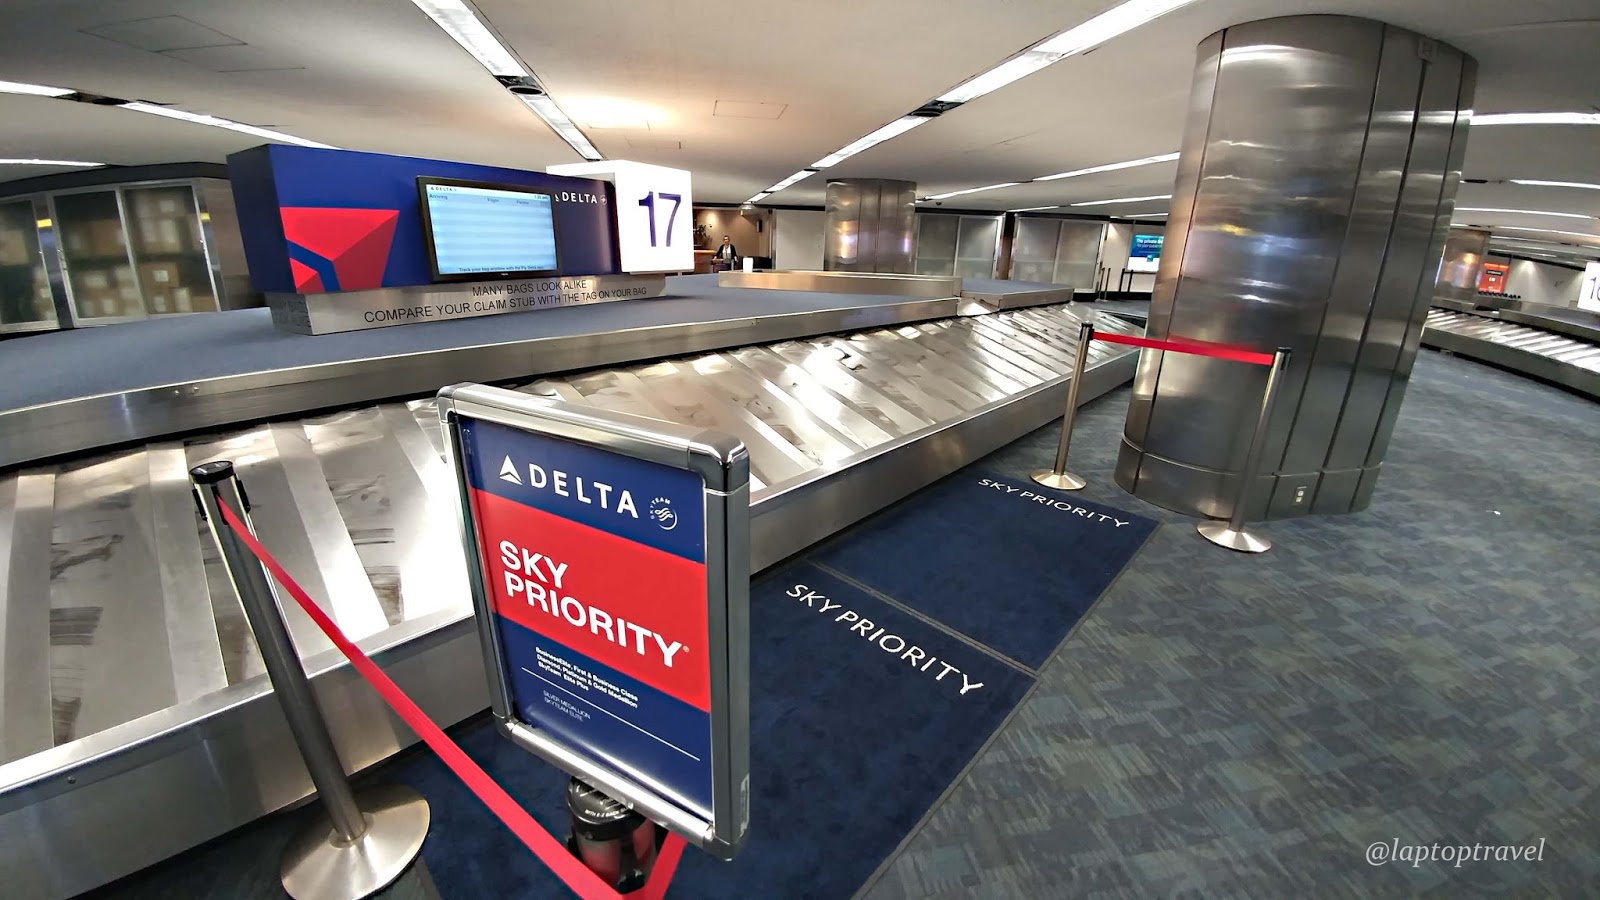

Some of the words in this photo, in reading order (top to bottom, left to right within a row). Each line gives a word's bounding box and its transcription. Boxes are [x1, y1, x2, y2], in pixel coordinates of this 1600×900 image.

[561, 191, 598, 204] DELTA
[638, 191, 682, 247] 17
[364, 306, 433, 322] COMPARE
[436, 302, 471, 315] YOUR
[474, 299, 507, 311] CLAIM
[510, 297, 535, 308] STUB
[538, 294, 560, 305] WITH
[563, 293, 580, 302] THE
[581, 291, 597, 301] TAG
[599, 290, 610, 299] ON
[611, 288, 631, 298] YOUR
[633, 287, 647, 296] BAG
[473, 285, 503, 296] MANY
[507, 283, 533, 294] BAGS
[536, 281, 561, 292] LOOK
[564, 279, 587, 290] ALIKE
[529, 463, 639, 518] DELTA
[500, 540, 568, 589] SKY
[562, 666, 587, 682] Platinum
[593, 682, 607, 693] Gold
[608, 689, 638, 708] Medallion
[563, 673, 576, 685] Elite
[576, 681, 589, 691] Plus
[574, 665, 587, 676] First
[593, 674, 620, 692] Business
[620, 688, 639, 701] Class
